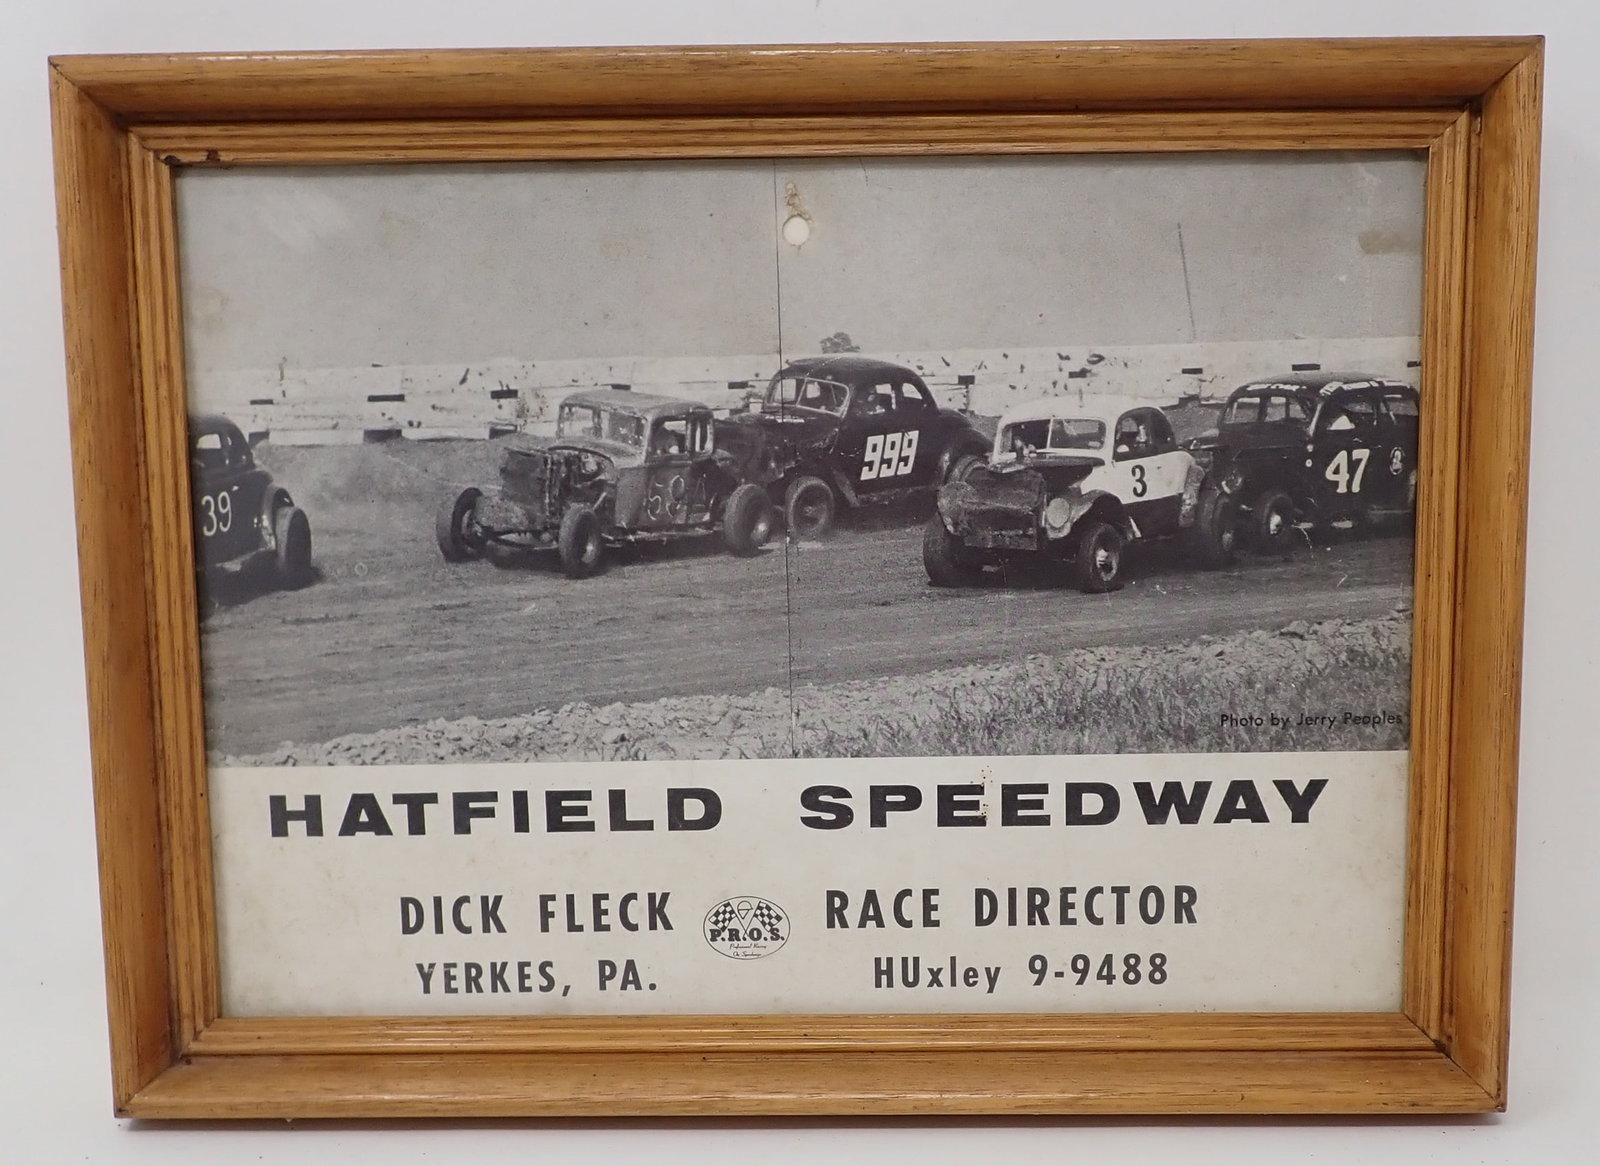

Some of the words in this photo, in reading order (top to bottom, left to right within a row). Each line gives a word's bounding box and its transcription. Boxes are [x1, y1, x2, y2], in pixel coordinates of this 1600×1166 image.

[859, 429, 920, 481] 999
[1325, 447, 1371, 494] 47
[1130, 464, 1148, 498] 3
[200, 490, 232, 537] 39
[1220, 714, 1264, 727] Photo
[1270, 712, 1290, 730] by
[1297, 713, 1337, 729] Jerry
[1343, 711, 1403, 731] Peoples
[270, 788, 722, 837] HATFIELD
[800, 779, 1328, 830] SPEEDWAY
[401, 895, 507, 934] DICK
[540, 892, 673, 932] FLECK
[827, 889, 940, 929] RACE
[974, 885, 1198, 927] DIRECTOR
[709, 927, 785, 942] P.R.O.S.
[416, 961, 571, 996] YERKES,
[599, 960, 657, 991] PA.
[874, 956, 1001, 993] HUxley
[1029, 953, 1168, 986] 9-9488
